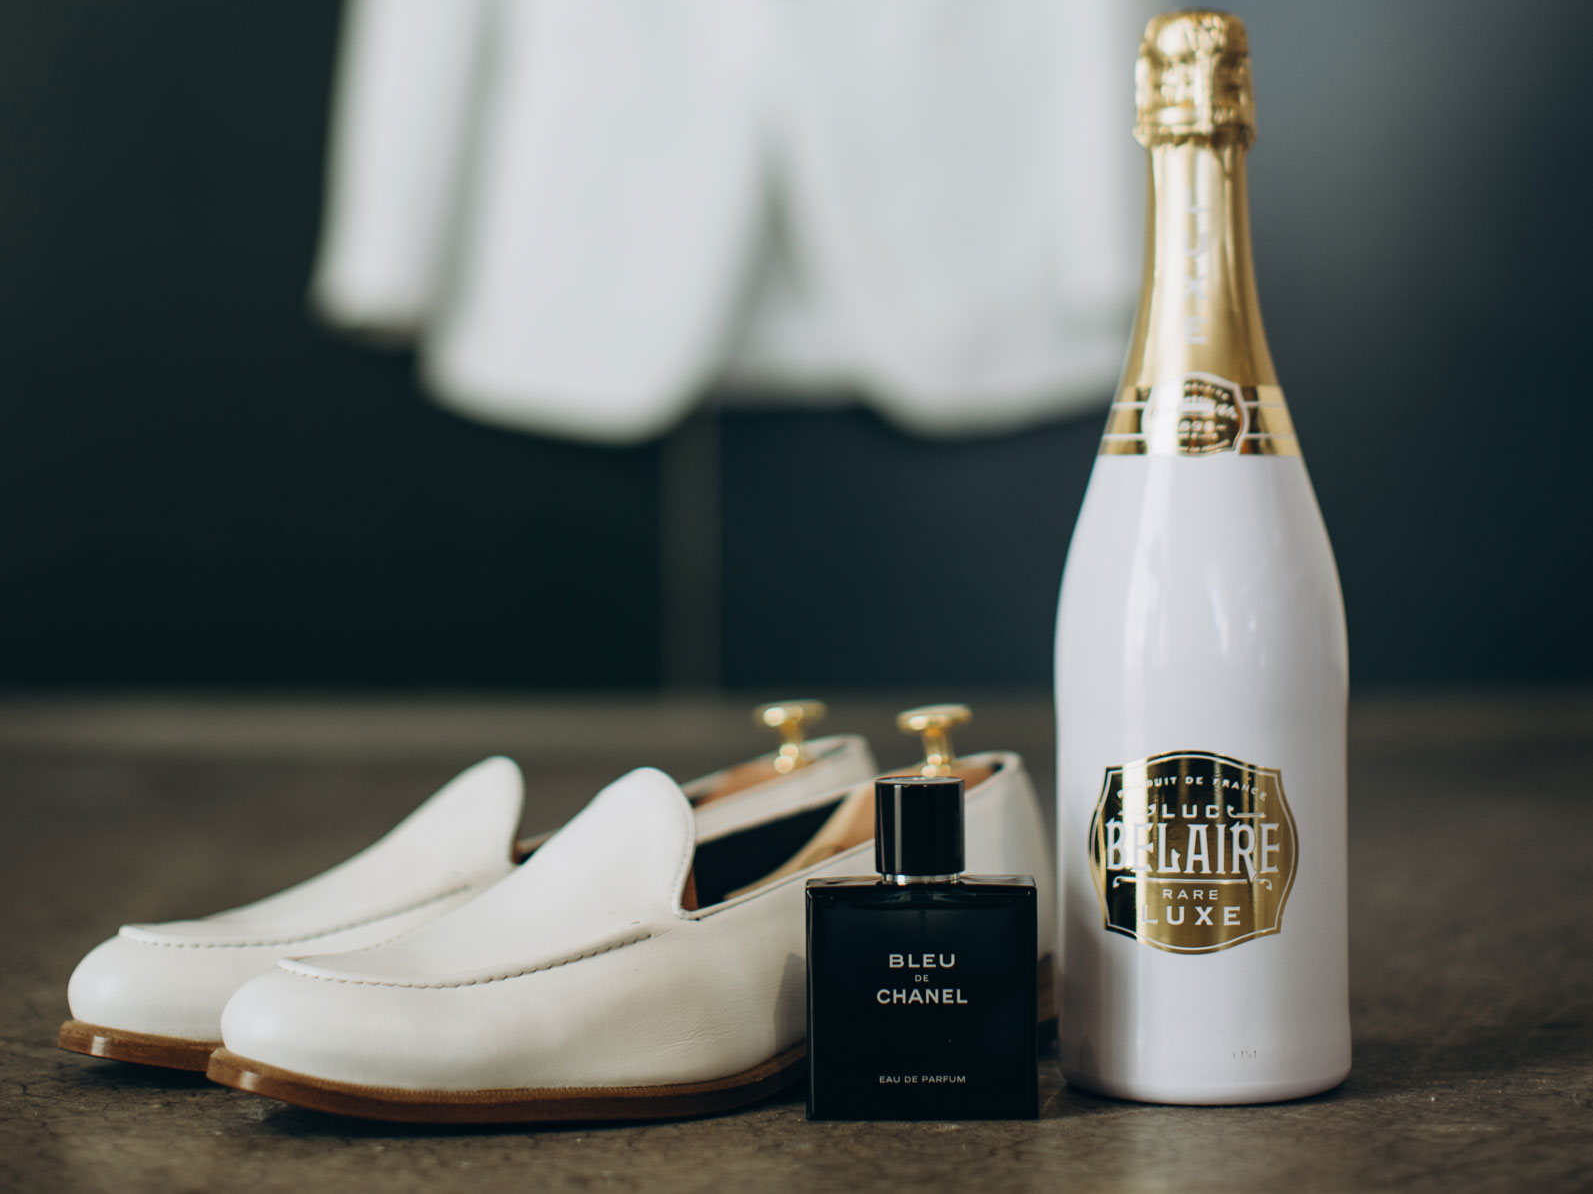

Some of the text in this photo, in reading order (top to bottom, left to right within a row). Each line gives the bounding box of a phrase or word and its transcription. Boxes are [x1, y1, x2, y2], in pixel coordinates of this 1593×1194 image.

[1184, 776, 1203, 785] DE
[1213, 777, 1267, 801] FRANCE
[1162, 804, 1220, 819] LUC
[1105, 818, 1280, 883] BELAIRE
[1162, 889, 1219, 900] RARE
[1142, 906, 1241, 926] LUXE
[889, 953, 955, 968] BLEU
[914, 974, 929, 982] DE
[876, 988, 968, 1004] CHANEL
[879, 1075, 966, 1083] EAU DE PARFUM
